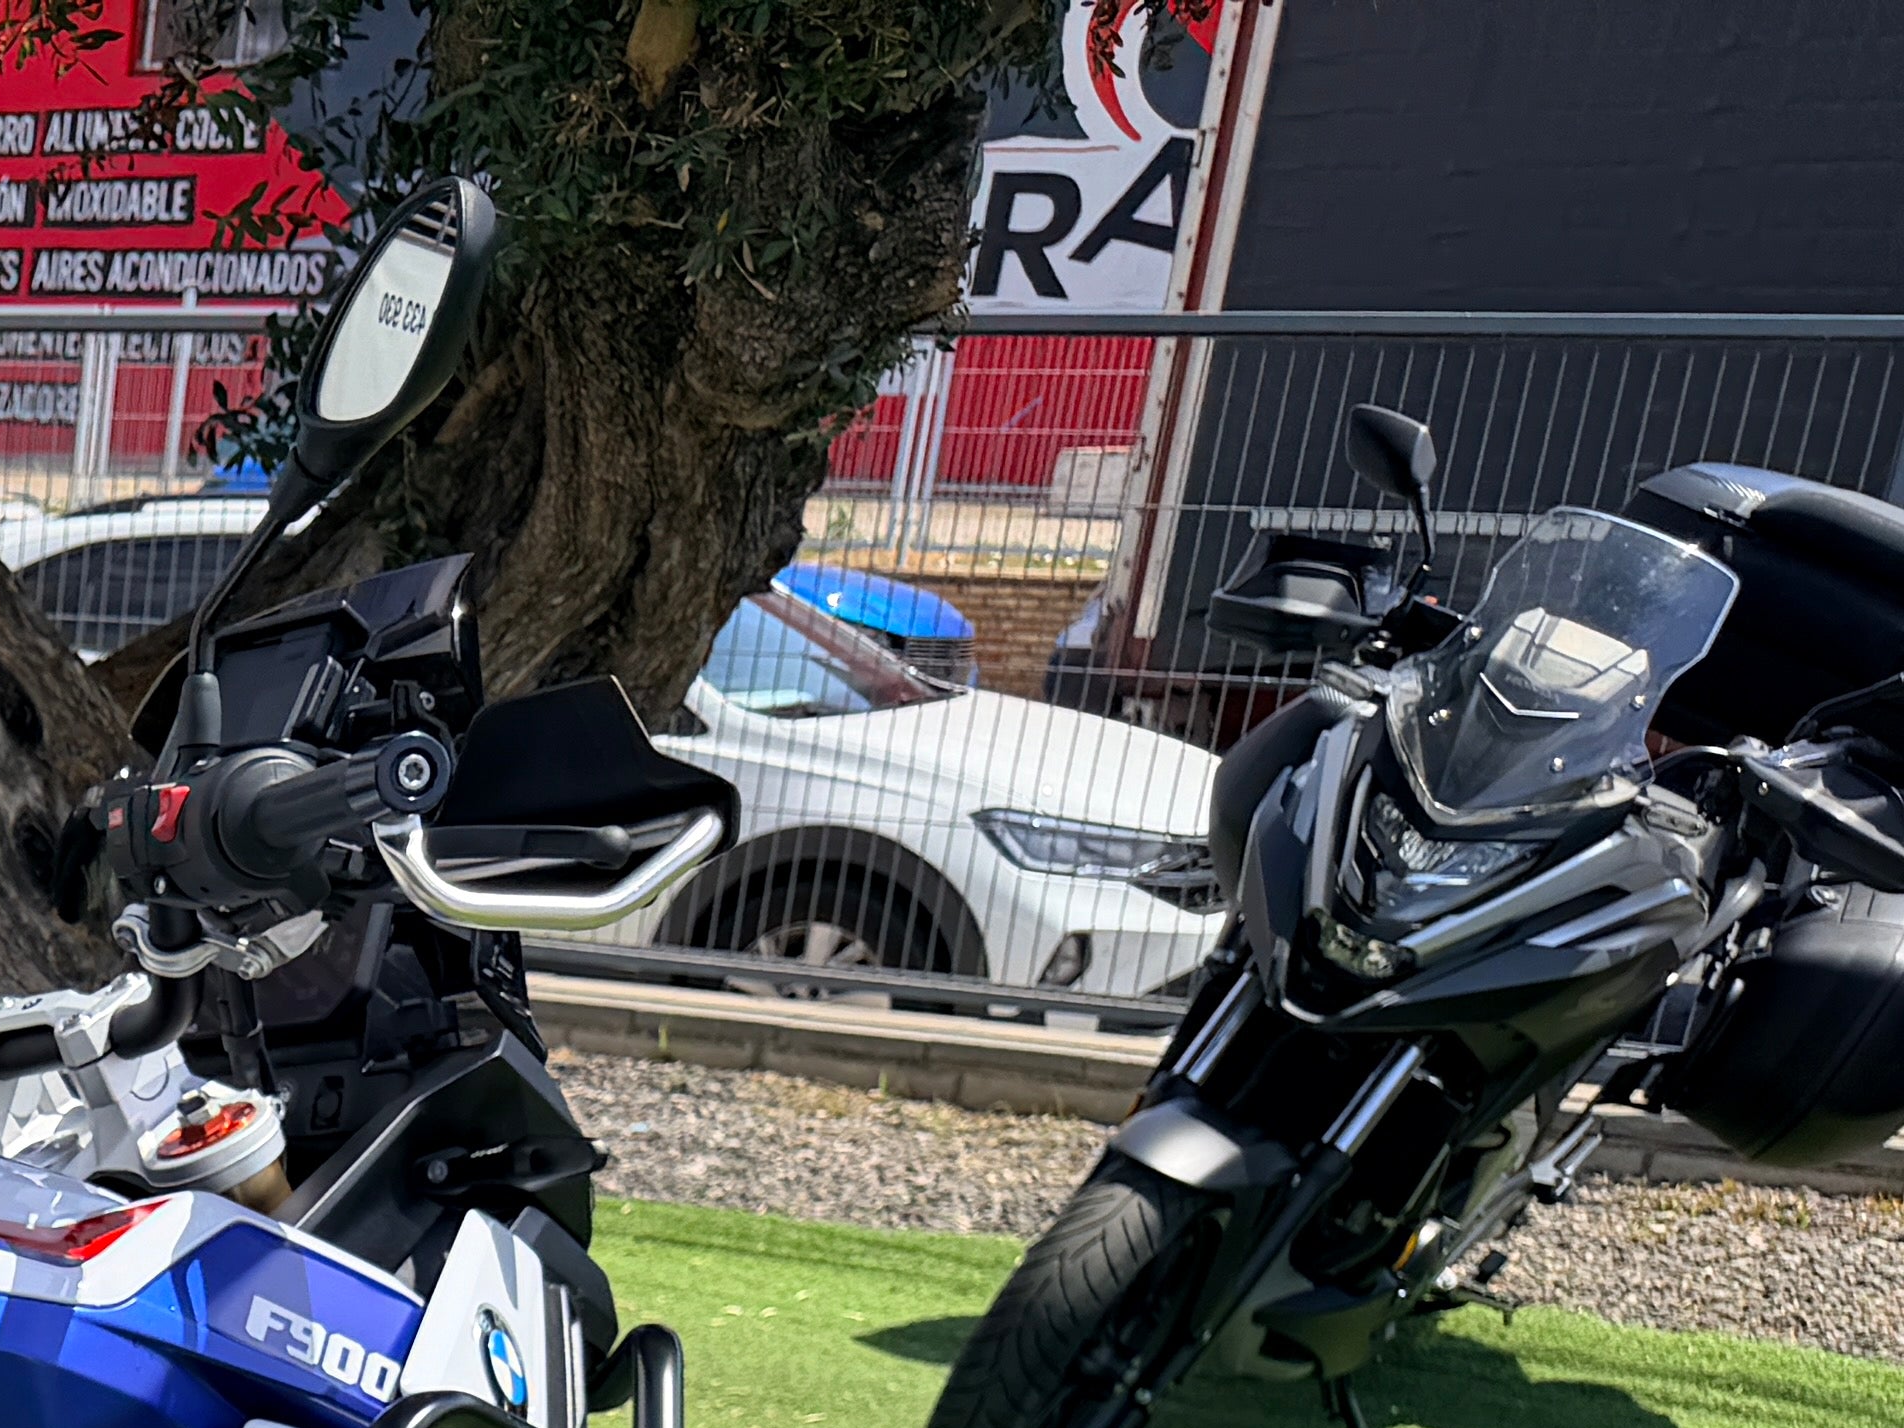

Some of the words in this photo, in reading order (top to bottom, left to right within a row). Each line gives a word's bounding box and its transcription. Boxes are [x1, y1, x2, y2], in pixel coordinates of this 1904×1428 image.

[31, 250, 105, 291] AIRES
[106, 250, 326, 294] ACONDICIONADOS
[245, 1295, 401, 1403] F900
